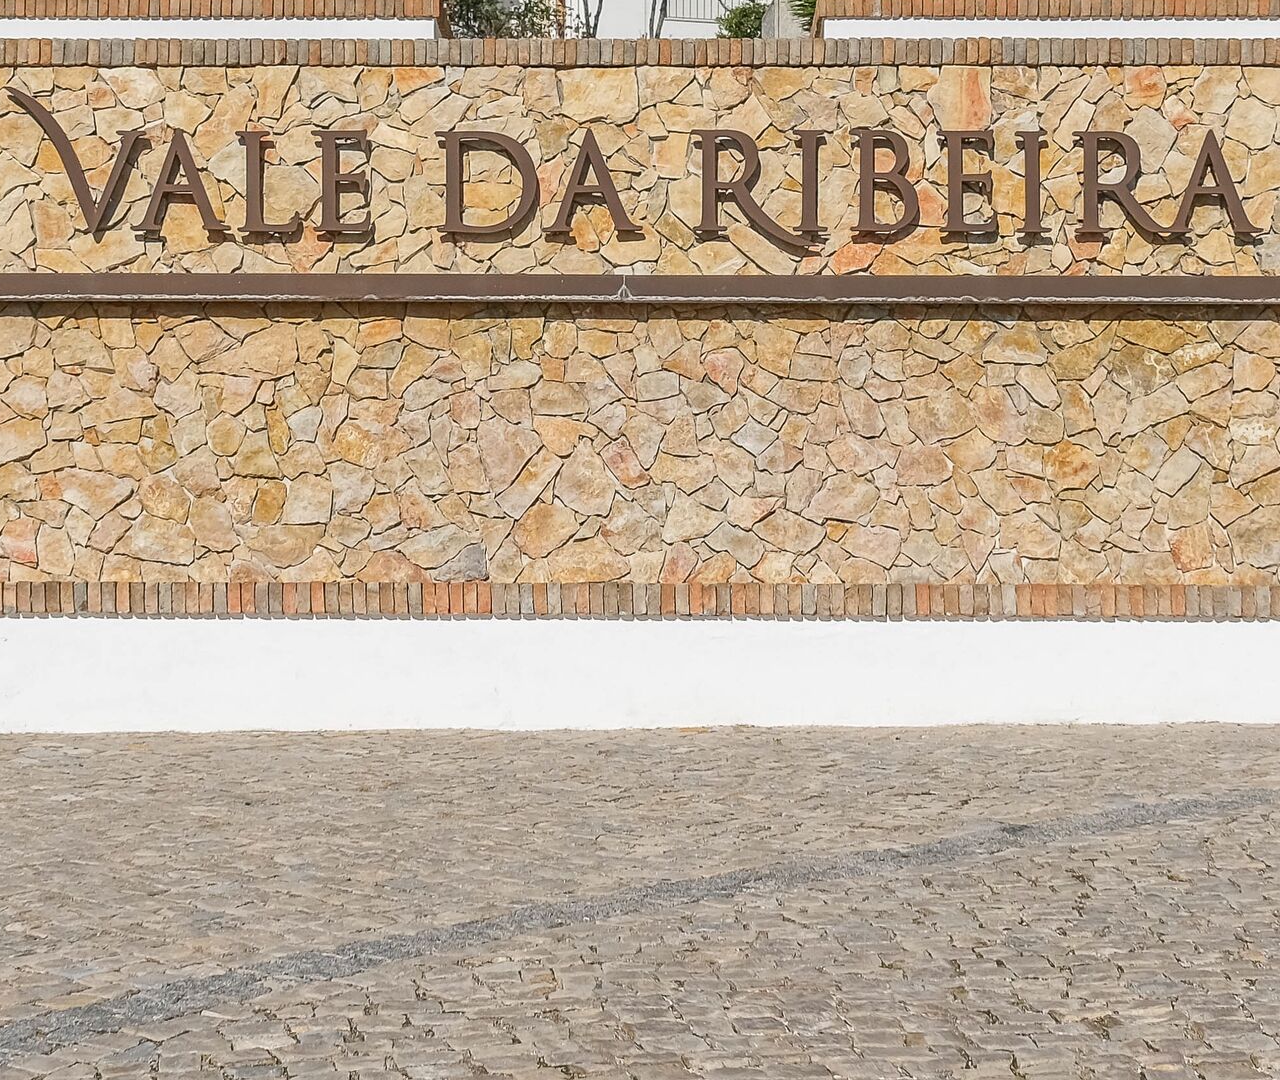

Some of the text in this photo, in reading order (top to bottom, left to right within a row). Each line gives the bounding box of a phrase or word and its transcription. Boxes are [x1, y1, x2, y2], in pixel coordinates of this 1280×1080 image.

[6, 85, 1264, 256] VALE DA RIBEIRA
